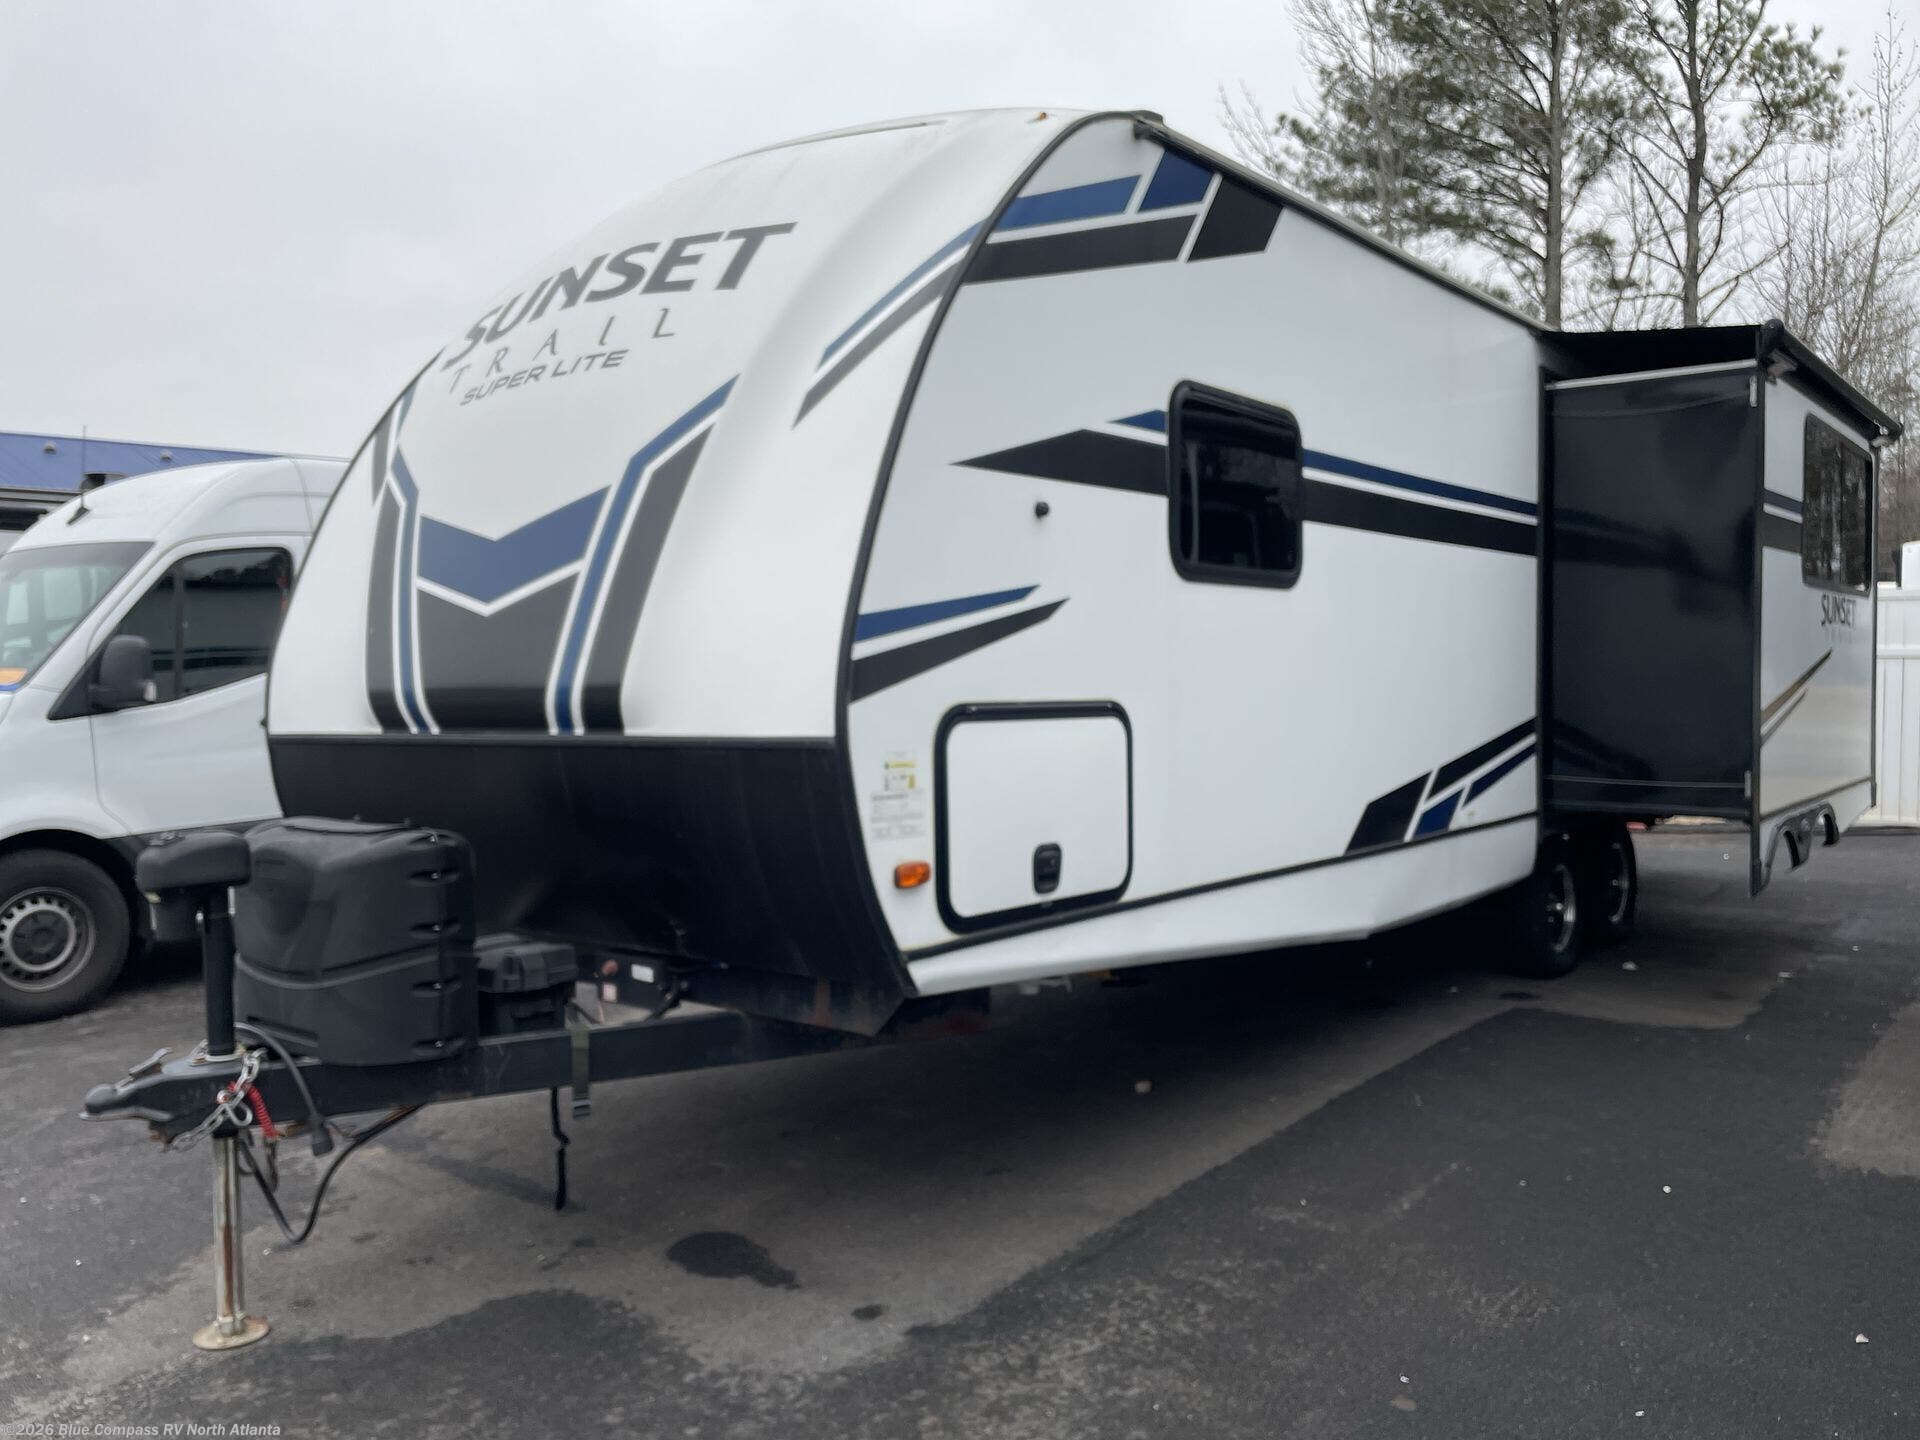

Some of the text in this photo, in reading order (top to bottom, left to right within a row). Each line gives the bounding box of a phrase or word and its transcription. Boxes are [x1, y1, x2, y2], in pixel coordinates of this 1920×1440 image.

[440, 222, 798, 371] SUNSET
[449, 308, 675, 394] TRAIL
[1821, 592, 1857, 629] SUNSET
